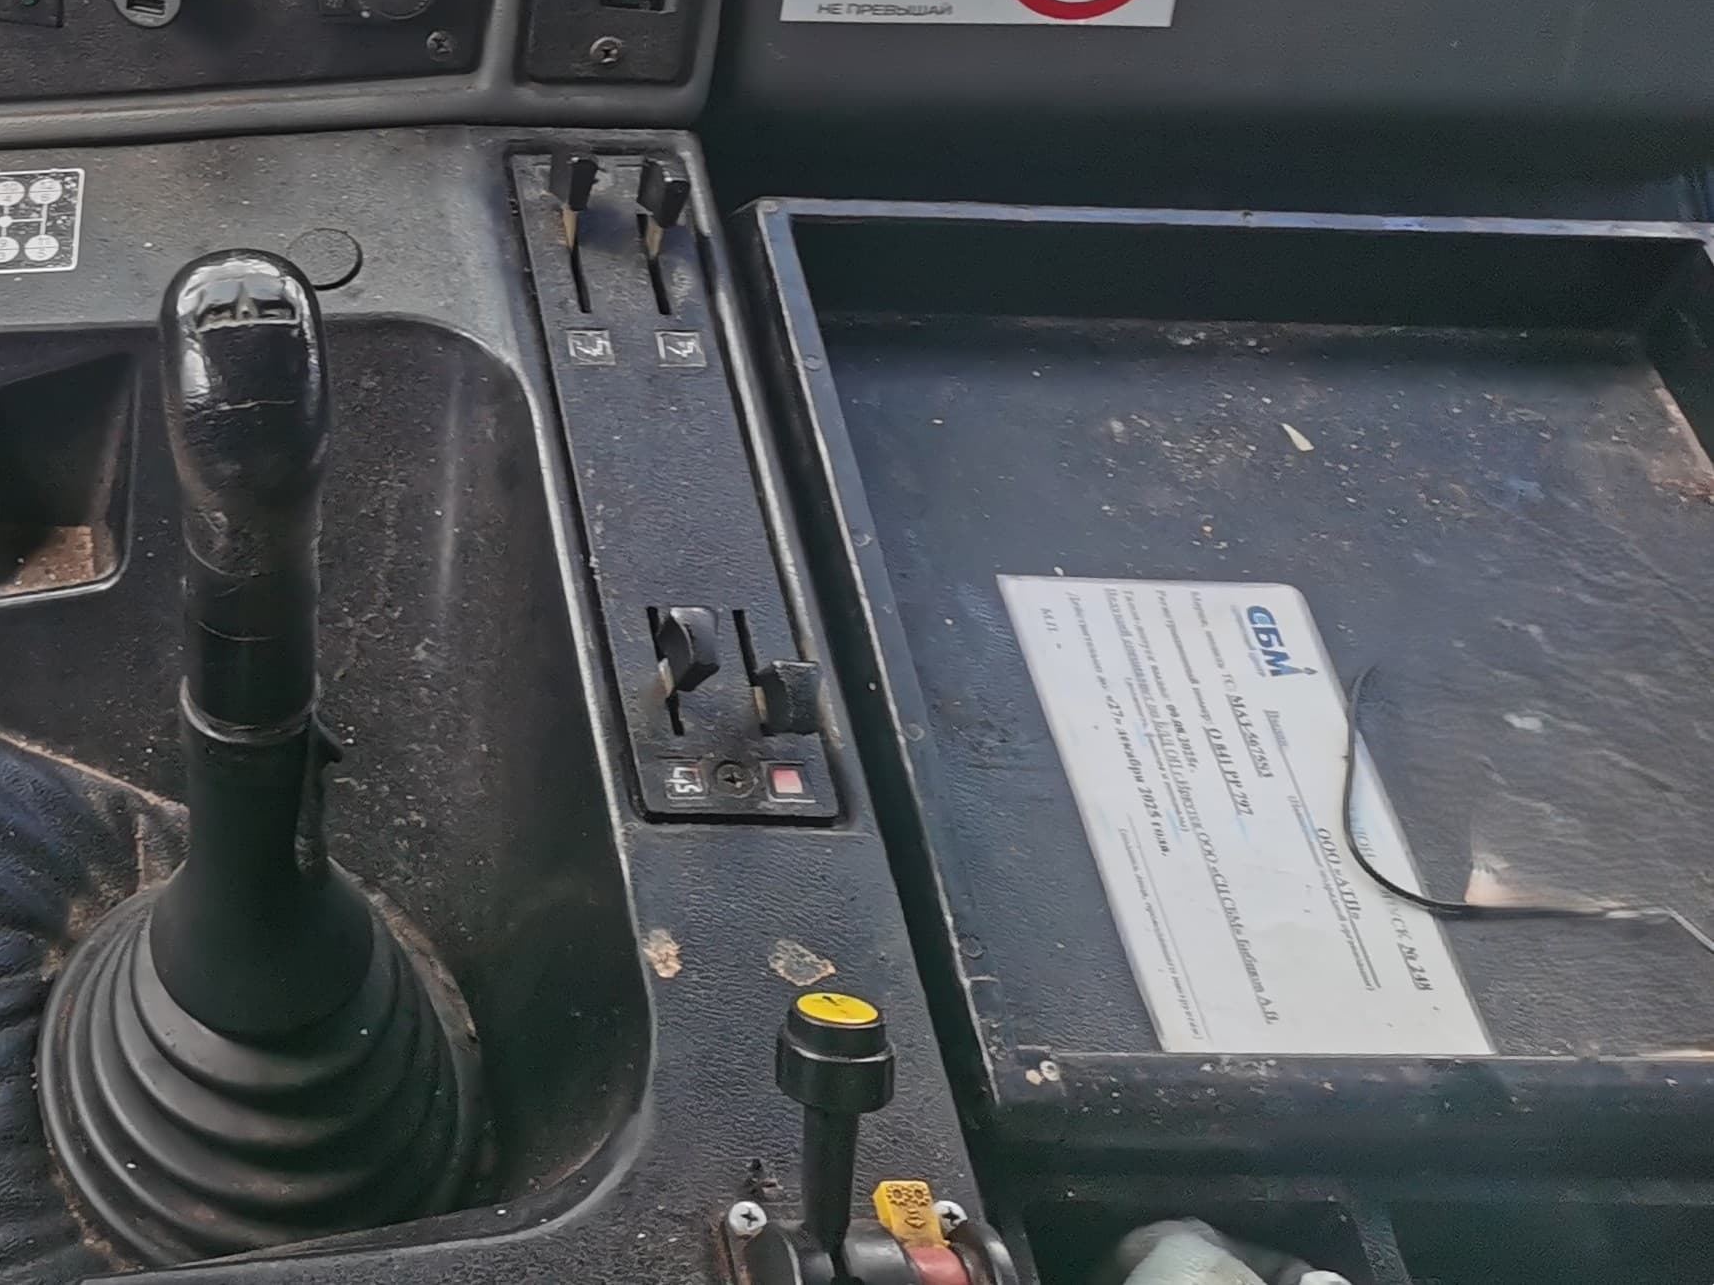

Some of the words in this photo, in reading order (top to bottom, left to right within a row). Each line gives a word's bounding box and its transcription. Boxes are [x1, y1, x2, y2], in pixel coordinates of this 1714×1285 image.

[817, 3, 843, 15] НЕ
[846, 1, 953, 16] ПРЕВЫШАЙ
[1247, 605, 1298, 678] СБМ
[1138, 787, 1161, 817] 2025
[1315, 829, 1342, 863] ООО
